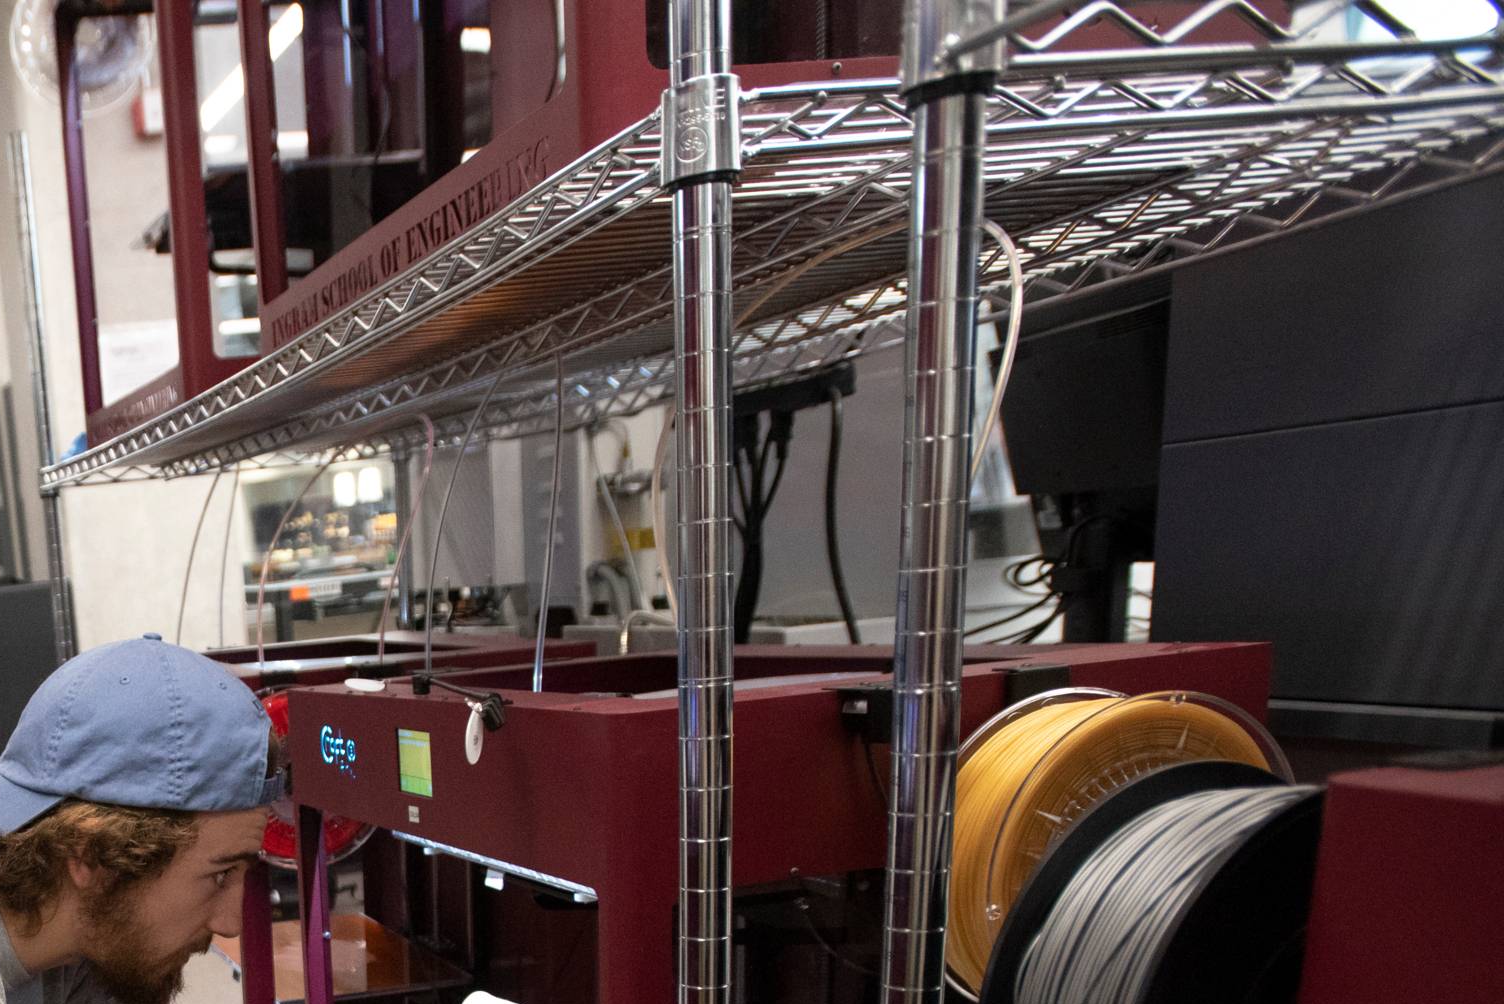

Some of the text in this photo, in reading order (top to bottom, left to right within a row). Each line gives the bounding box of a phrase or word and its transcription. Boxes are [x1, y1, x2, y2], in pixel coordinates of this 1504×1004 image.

[322, 266, 378, 323] SCHOOL
[380, 237, 401, 277] OF
[405, 135, 550, 263] ENGINEERING
